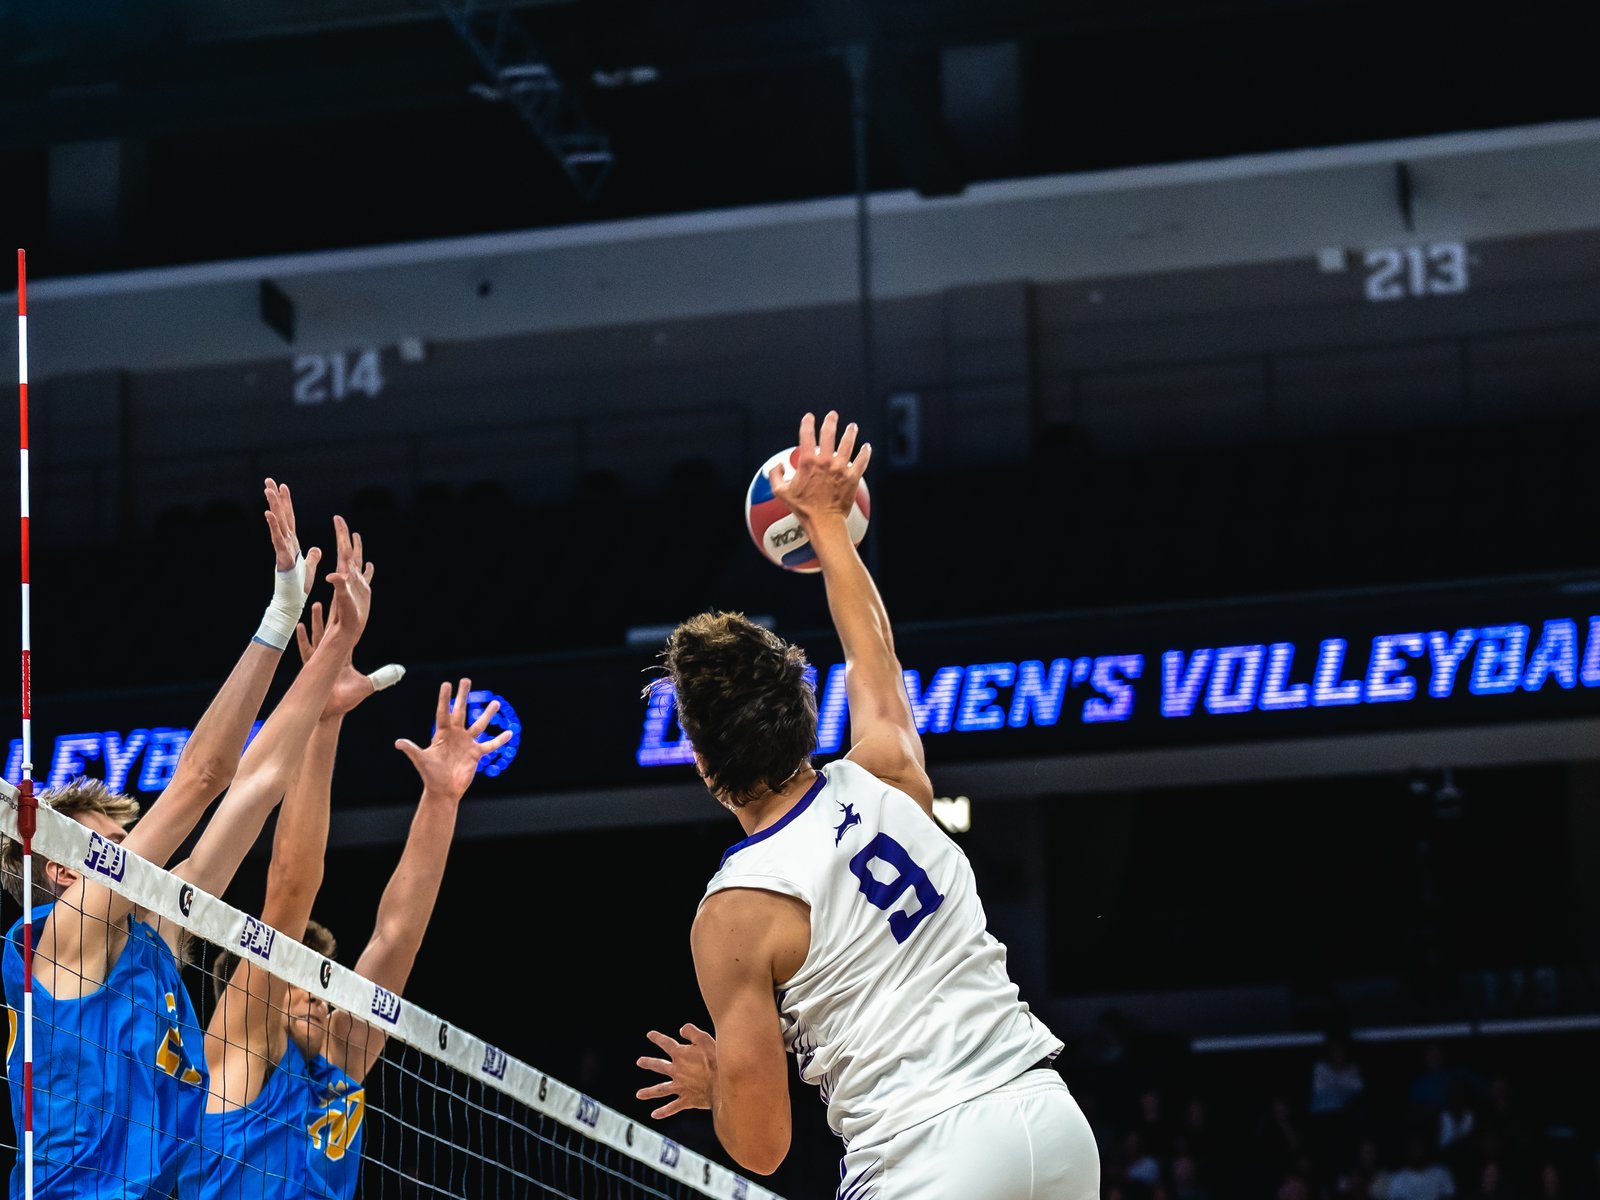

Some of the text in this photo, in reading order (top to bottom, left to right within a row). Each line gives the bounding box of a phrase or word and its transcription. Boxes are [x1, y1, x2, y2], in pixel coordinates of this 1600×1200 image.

[1363, 243, 1468, 300] 213
[293, 351, 382, 402] 214
[849, 832, 945, 944] 9
